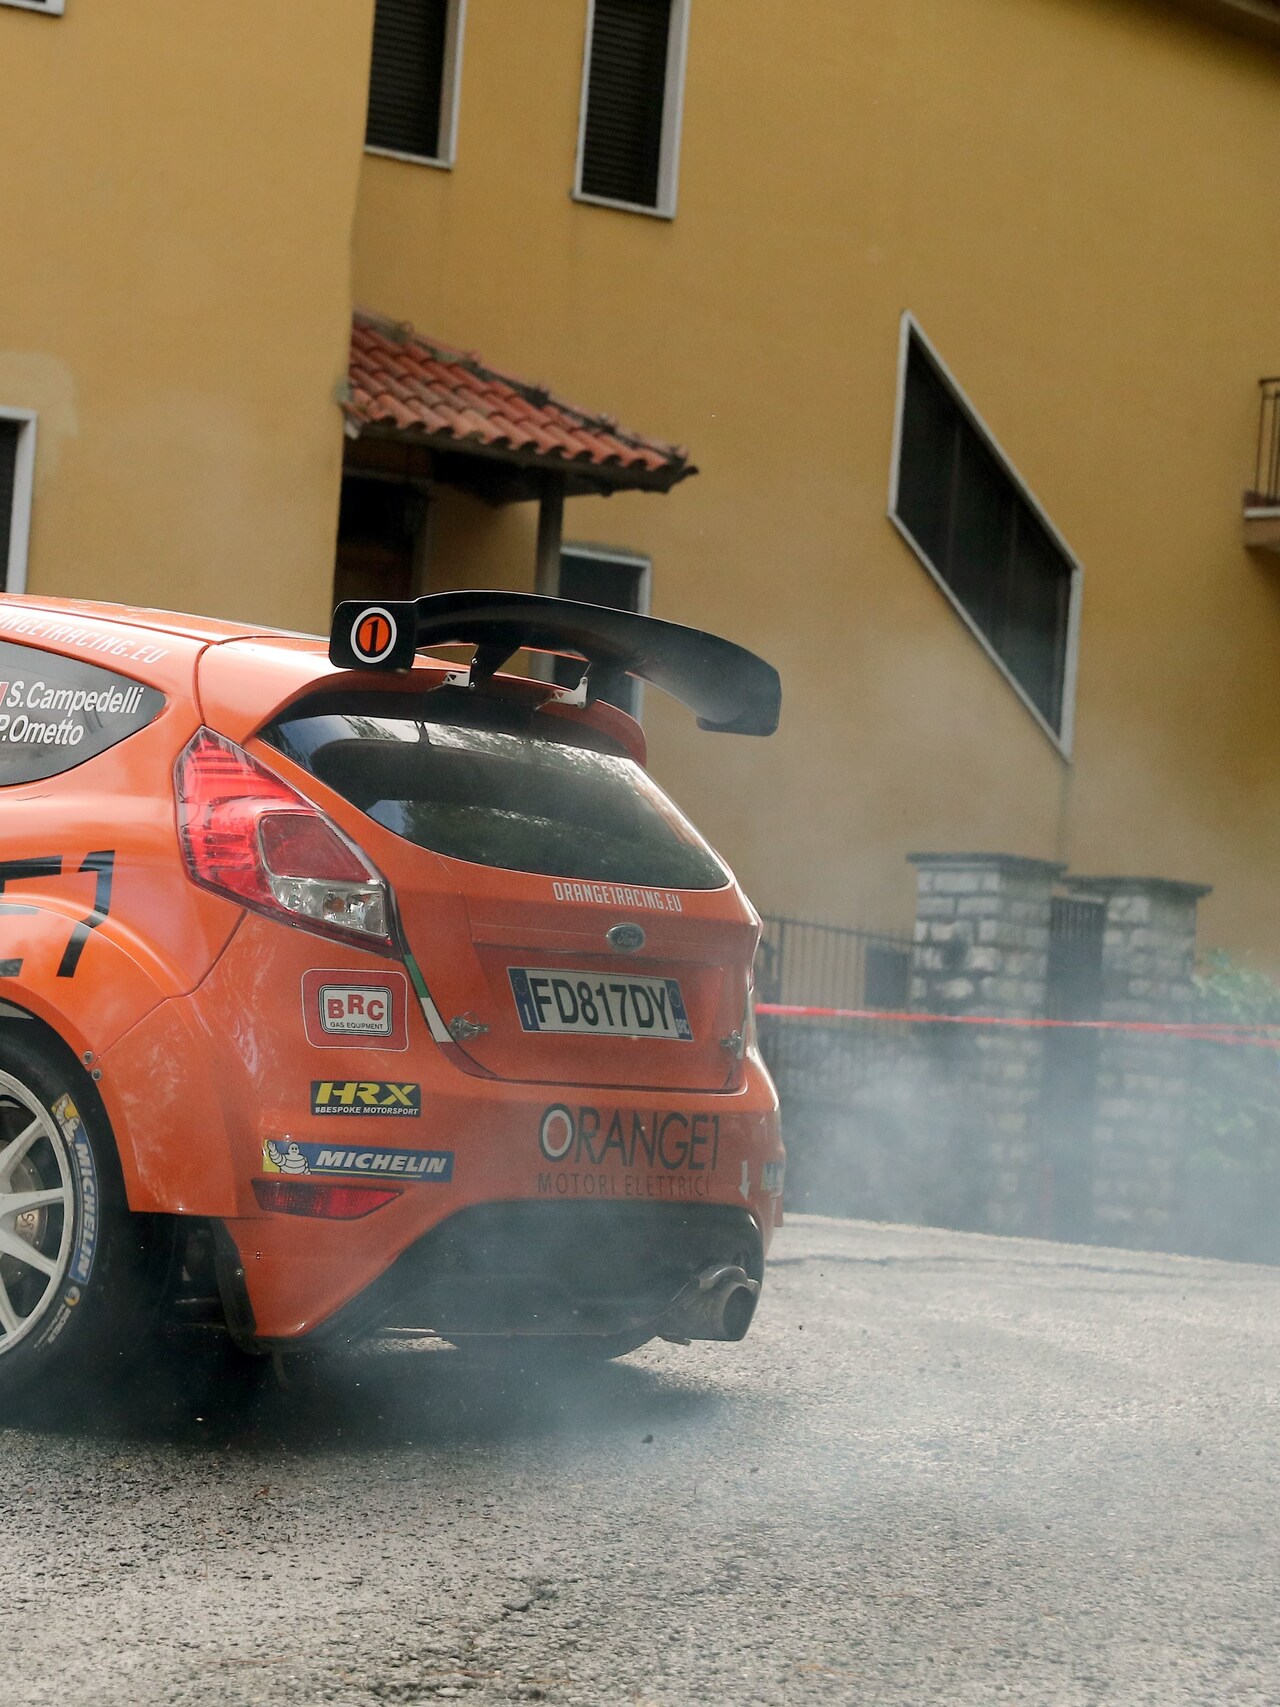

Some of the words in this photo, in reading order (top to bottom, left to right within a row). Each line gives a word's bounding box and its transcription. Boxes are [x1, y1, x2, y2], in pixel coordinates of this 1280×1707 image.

[363, 619, 380, 653] 1
[6, 681, 144, 716] S.Campedelli
[552, 881, 683, 913] ORANGE1RACING.EU
[327, 994, 384, 1021] BRC
[529, 977, 669, 1030] FD817DY
[346, 1022, 384, 1030] EQUIPMENT
[315, 1082, 417, 1106] HRX
[314, 1106, 361, 1114] #BESPOKE
[363, 1106, 419, 1116] MOTORSPORT
[538, 1102, 720, 1171] ORANGE1
[315, 1150, 447, 1174] MICHELIN
[537, 1172, 616, 1195] MOTORI
[624, 1175, 710, 1197] ELETTRICI
[75, 1143, 96, 1278] MICHELIN
